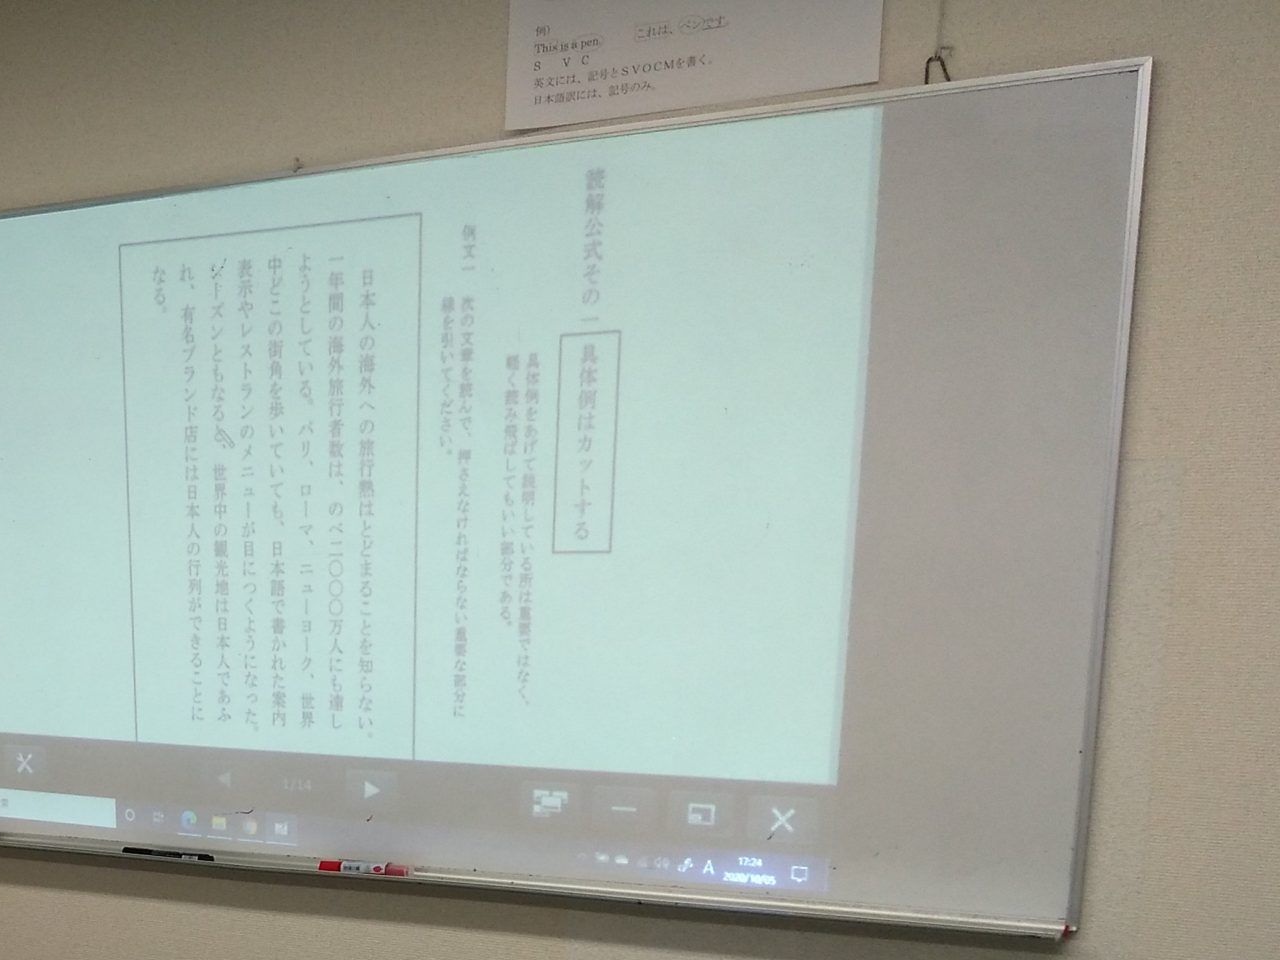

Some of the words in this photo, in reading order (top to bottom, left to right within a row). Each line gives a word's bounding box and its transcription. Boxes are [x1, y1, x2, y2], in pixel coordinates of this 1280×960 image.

[533, 61, 541, 72] S
[563, 56, 571, 67] V
[581, 55, 590, 65] C
[534, 41, 558, 54] This
[560, 41, 569, 52] is
[571, 42, 578, 50] a
[151, 265, 168, 314] なる。
[573, 343, 598, 541] 具体例はカットする
